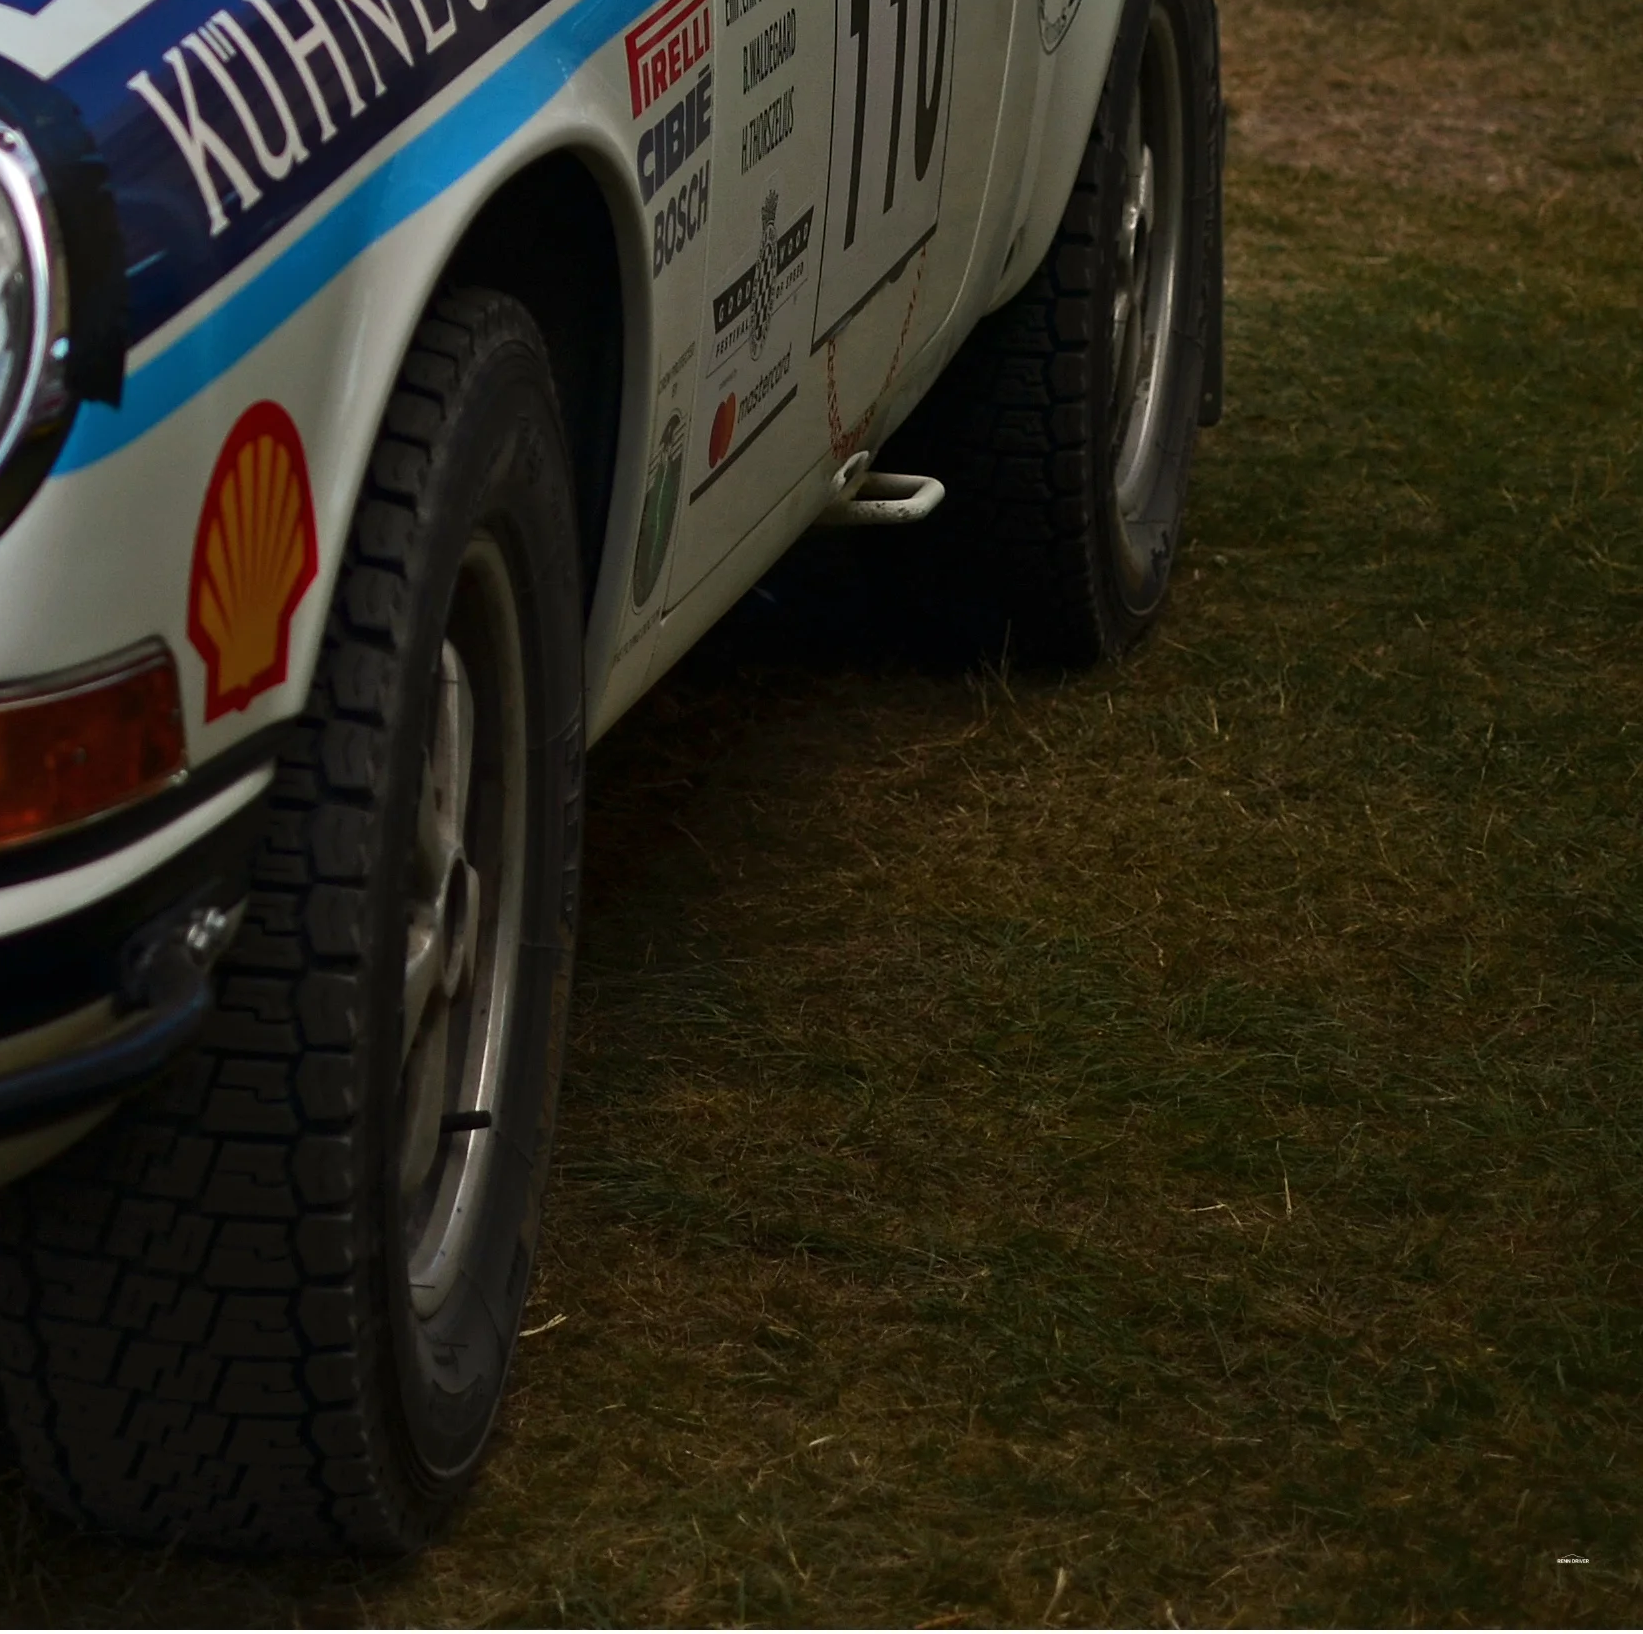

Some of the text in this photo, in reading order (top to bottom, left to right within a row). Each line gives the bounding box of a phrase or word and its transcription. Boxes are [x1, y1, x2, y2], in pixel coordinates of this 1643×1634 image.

[653, 160, 710, 281] BOSCH
[718, 221, 810, 323] GOOD WOOD
[715, 319, 750, 358] FESTIVAL
[737, 342, 793, 425] mastercard
